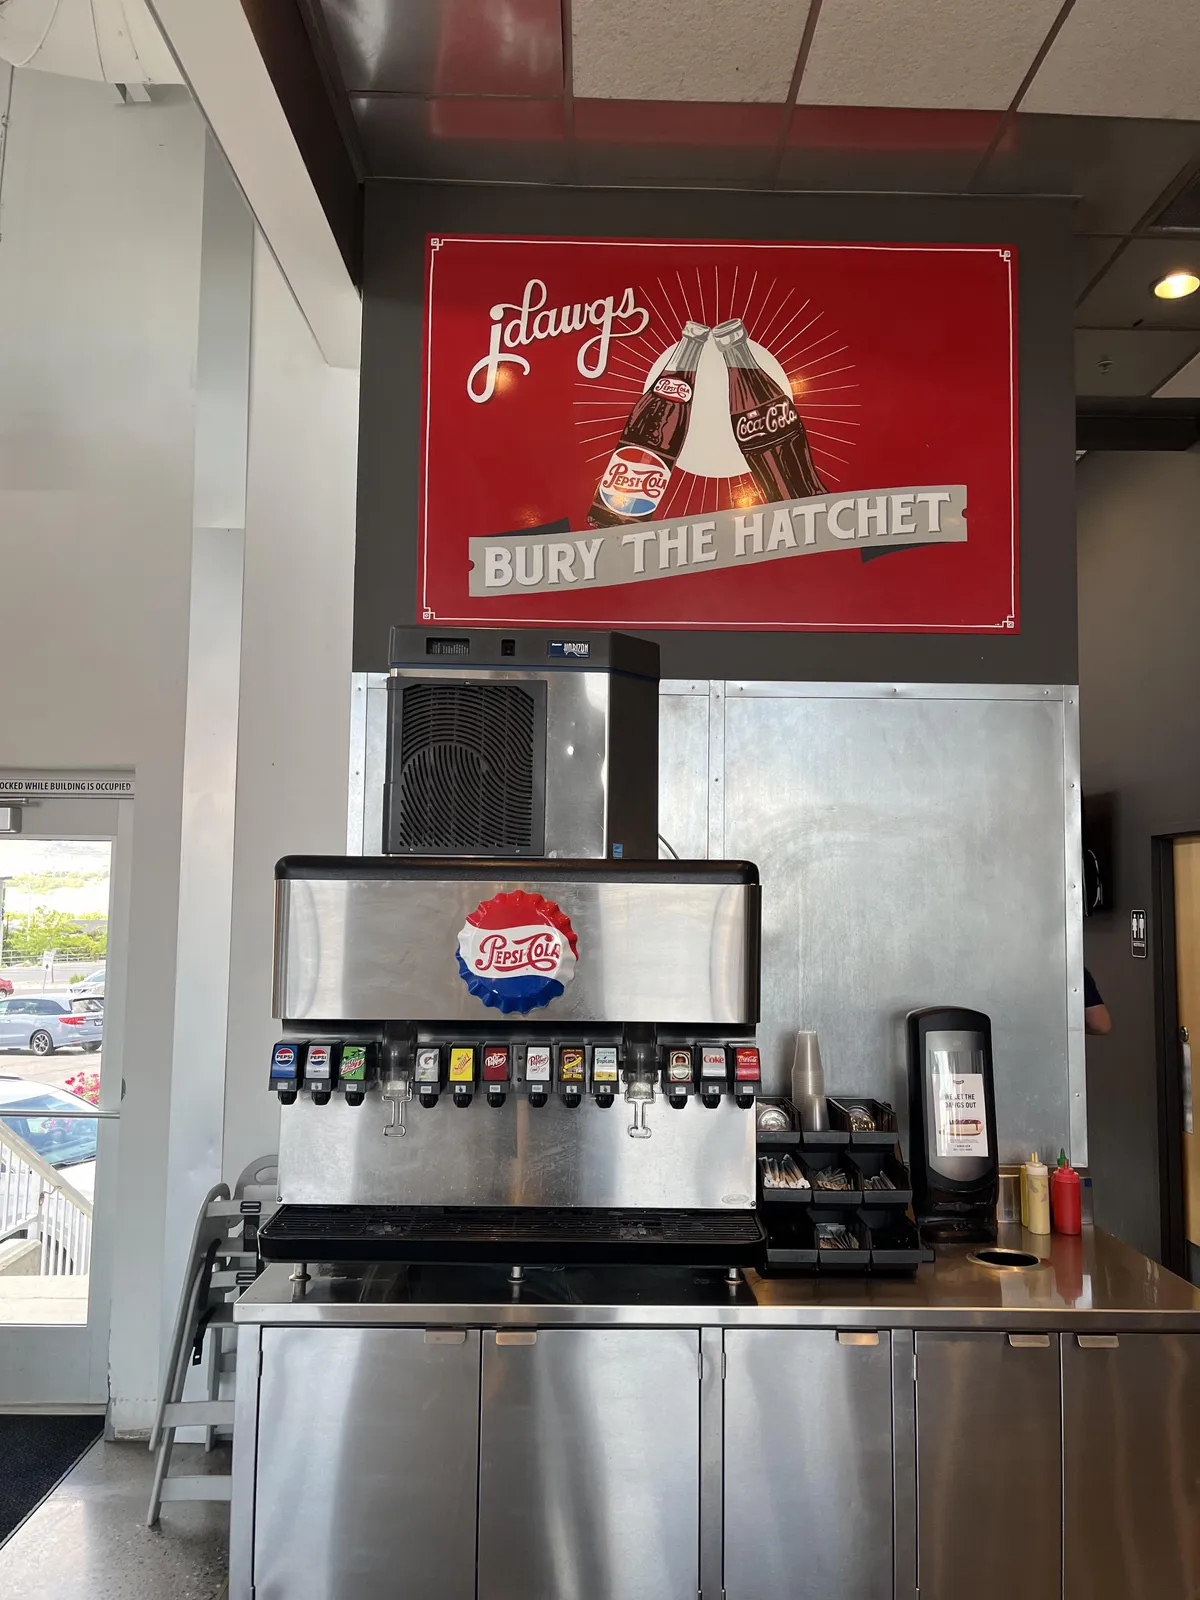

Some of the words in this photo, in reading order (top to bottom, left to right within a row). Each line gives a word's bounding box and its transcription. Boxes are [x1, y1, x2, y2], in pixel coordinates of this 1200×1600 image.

[736, 399, 797, 441] Coca-Cola
[484, 538, 605, 588] BURY
[621, 520, 718, 575] THE
[733, 492, 952, 557] HATCHET
[25, 782, 49, 790] WHILE
[50, 782, 86, 791] BUILDING
[95, 782, 131, 791] OCCUPIED
[703, 1055, 725, 1063] Coke
